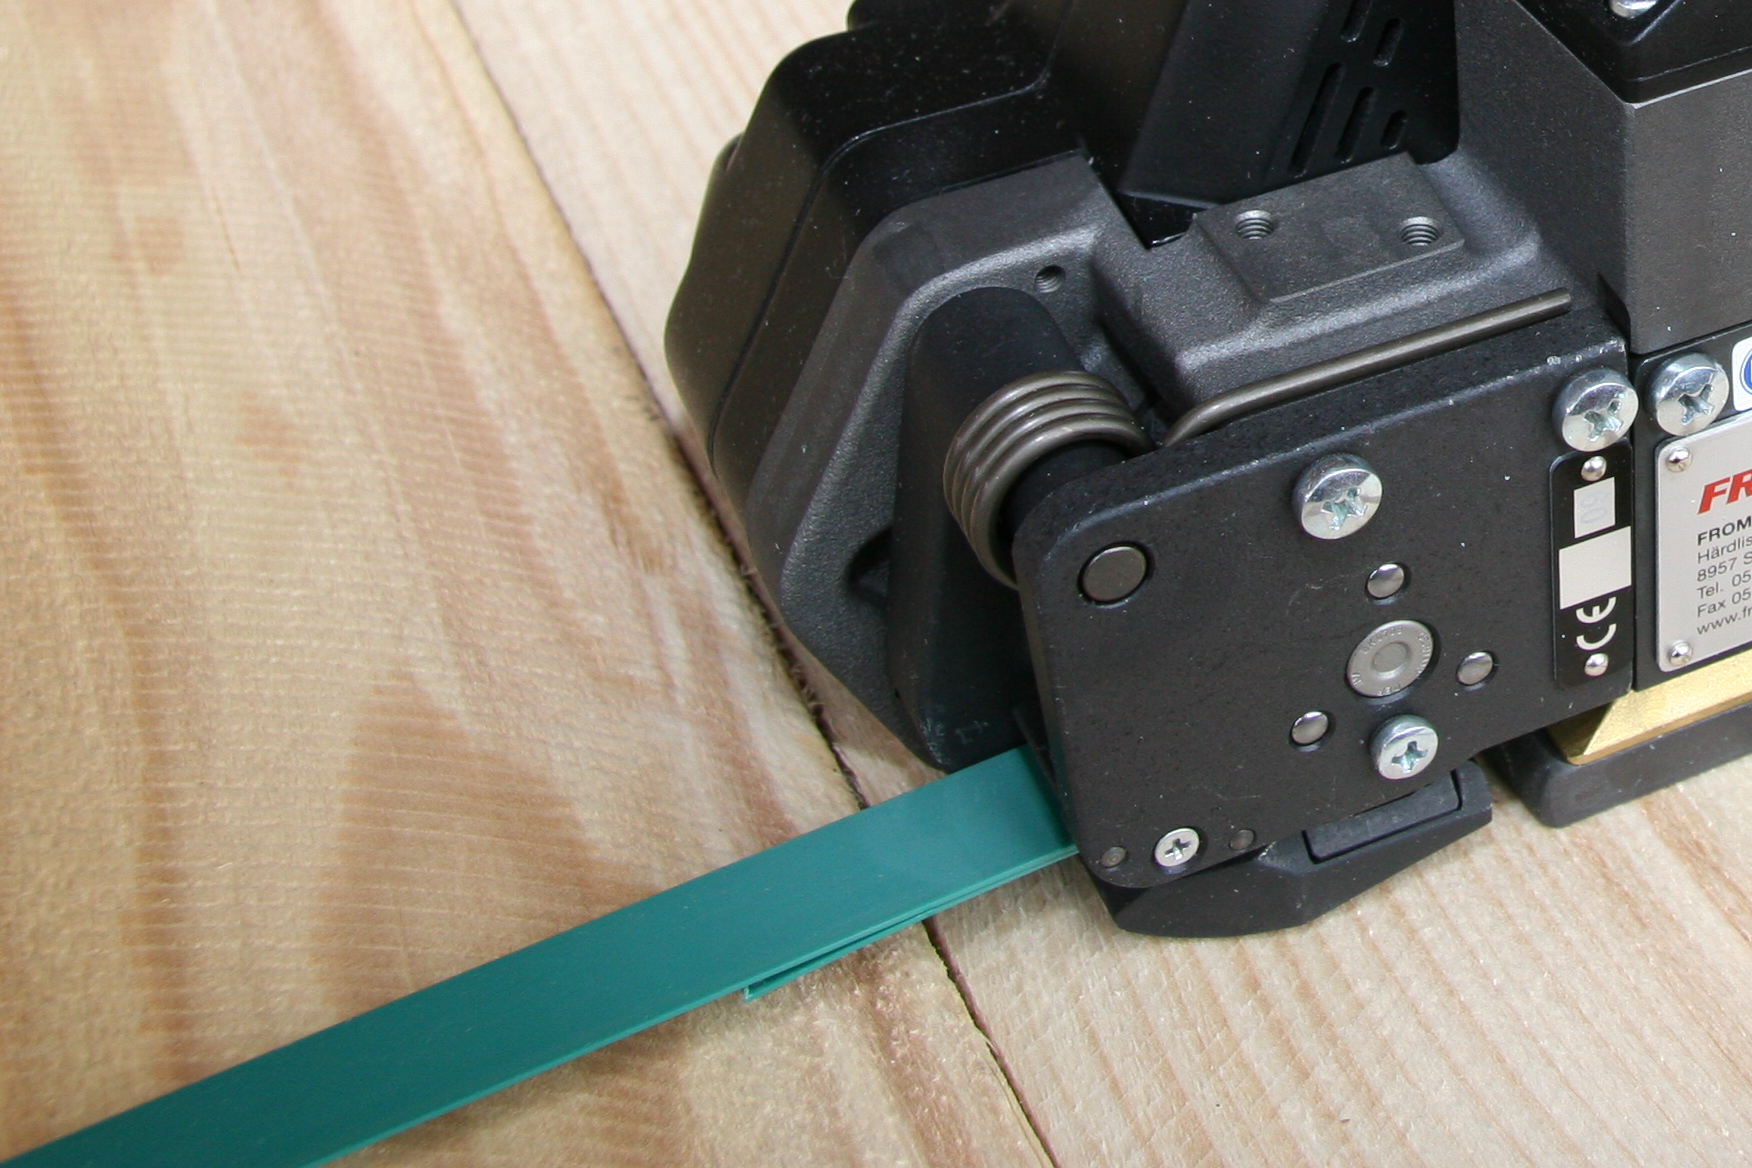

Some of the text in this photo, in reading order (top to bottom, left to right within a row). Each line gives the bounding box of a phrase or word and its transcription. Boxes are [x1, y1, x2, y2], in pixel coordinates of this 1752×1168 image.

[1697, 557, 1738, 582] 8957
[1697, 582, 1723, 600] Tel.
[1697, 600, 1726, 618] Fax
